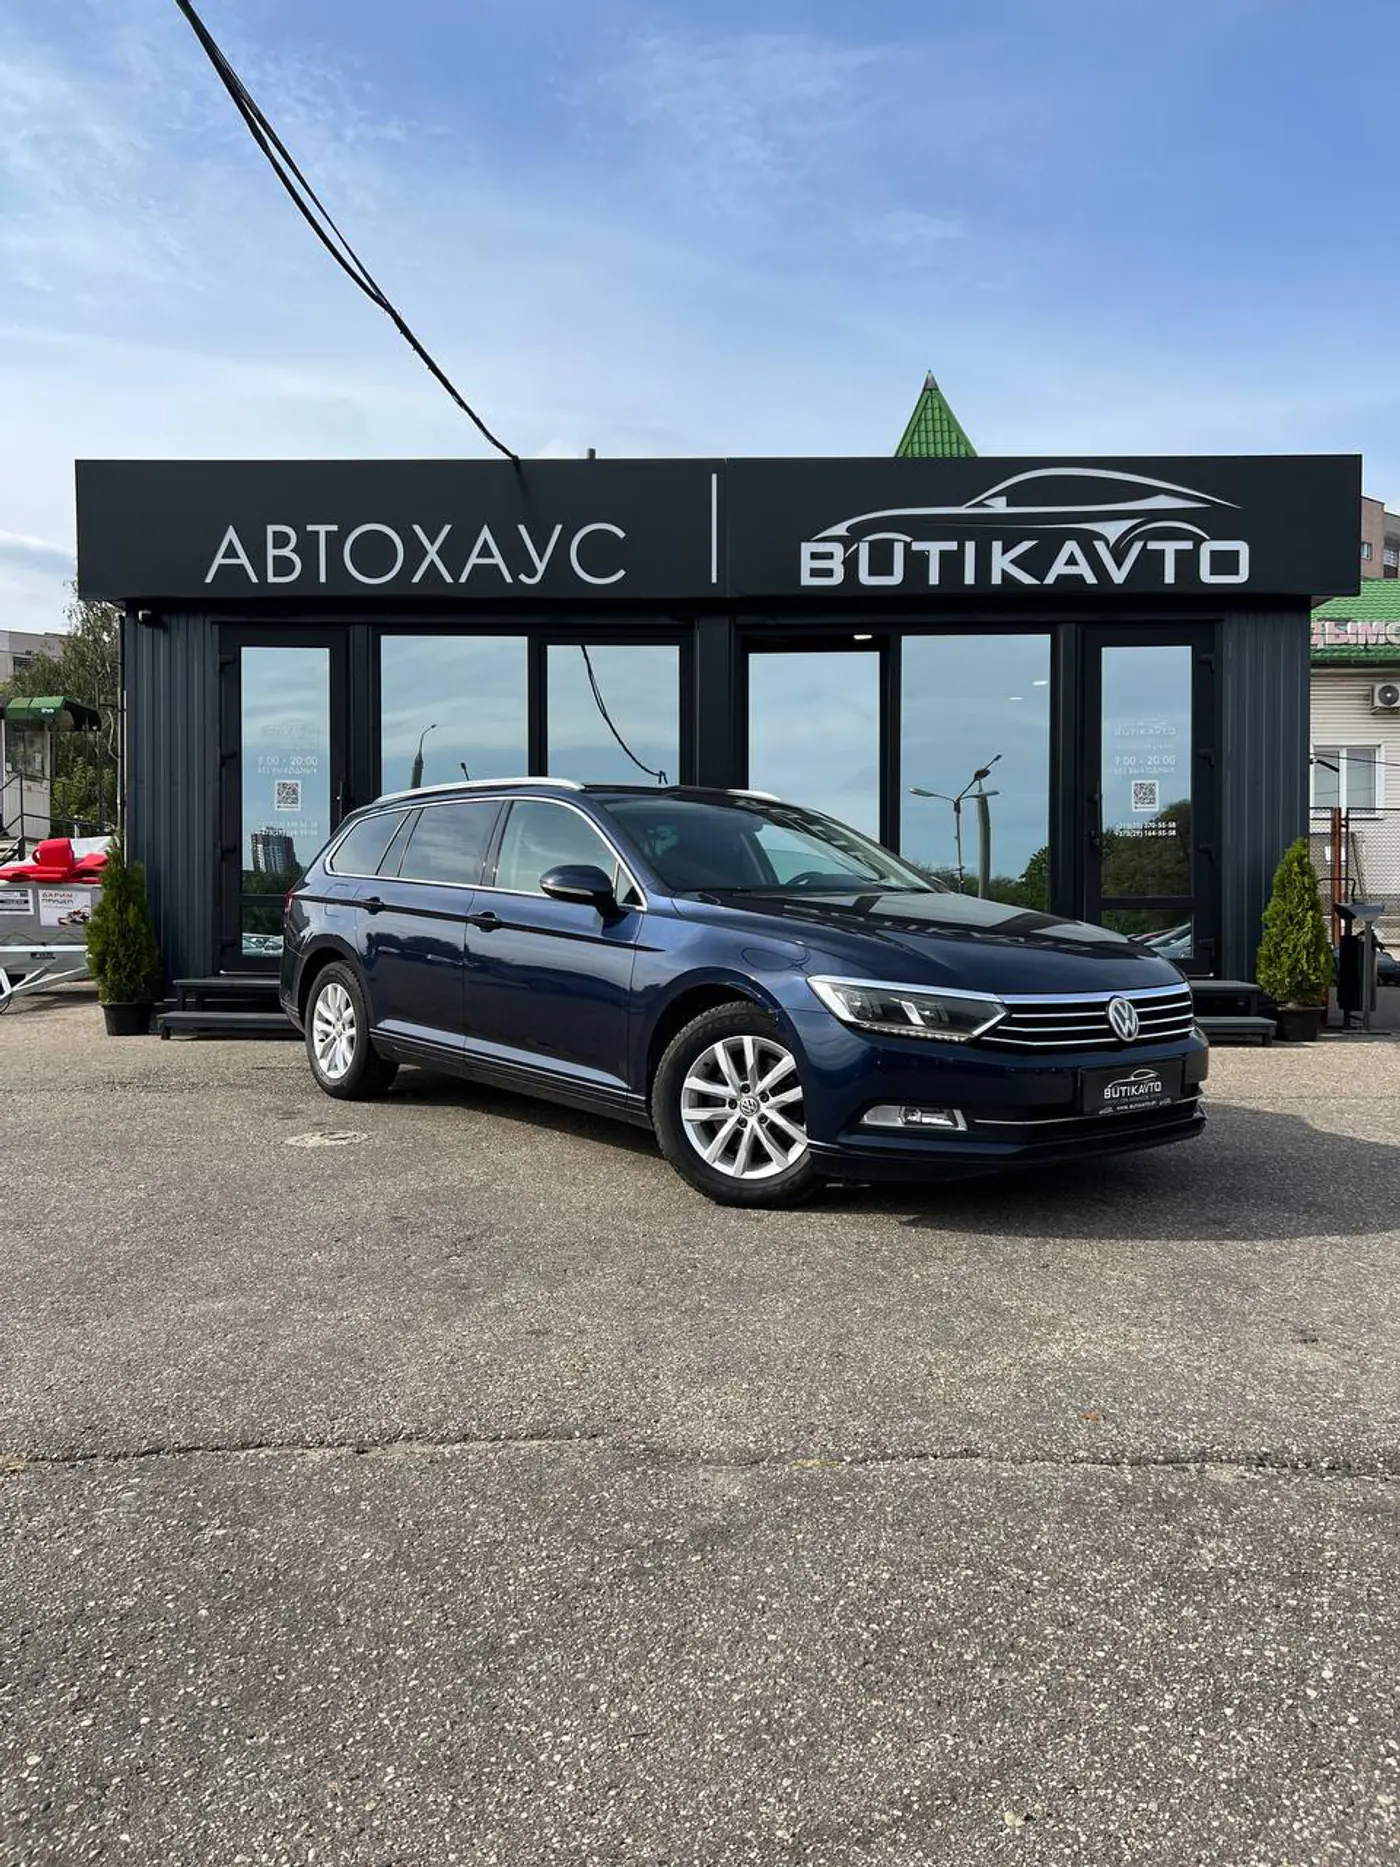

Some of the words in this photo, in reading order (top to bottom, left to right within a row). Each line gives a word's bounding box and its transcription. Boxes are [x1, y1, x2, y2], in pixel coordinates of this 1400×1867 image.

[204, 522, 628, 585] АВТОХАУС
[800, 539, 1250, 587] BUTIKAVTO
[1104, 1081, 1162, 1099] BUTIKAVTO
